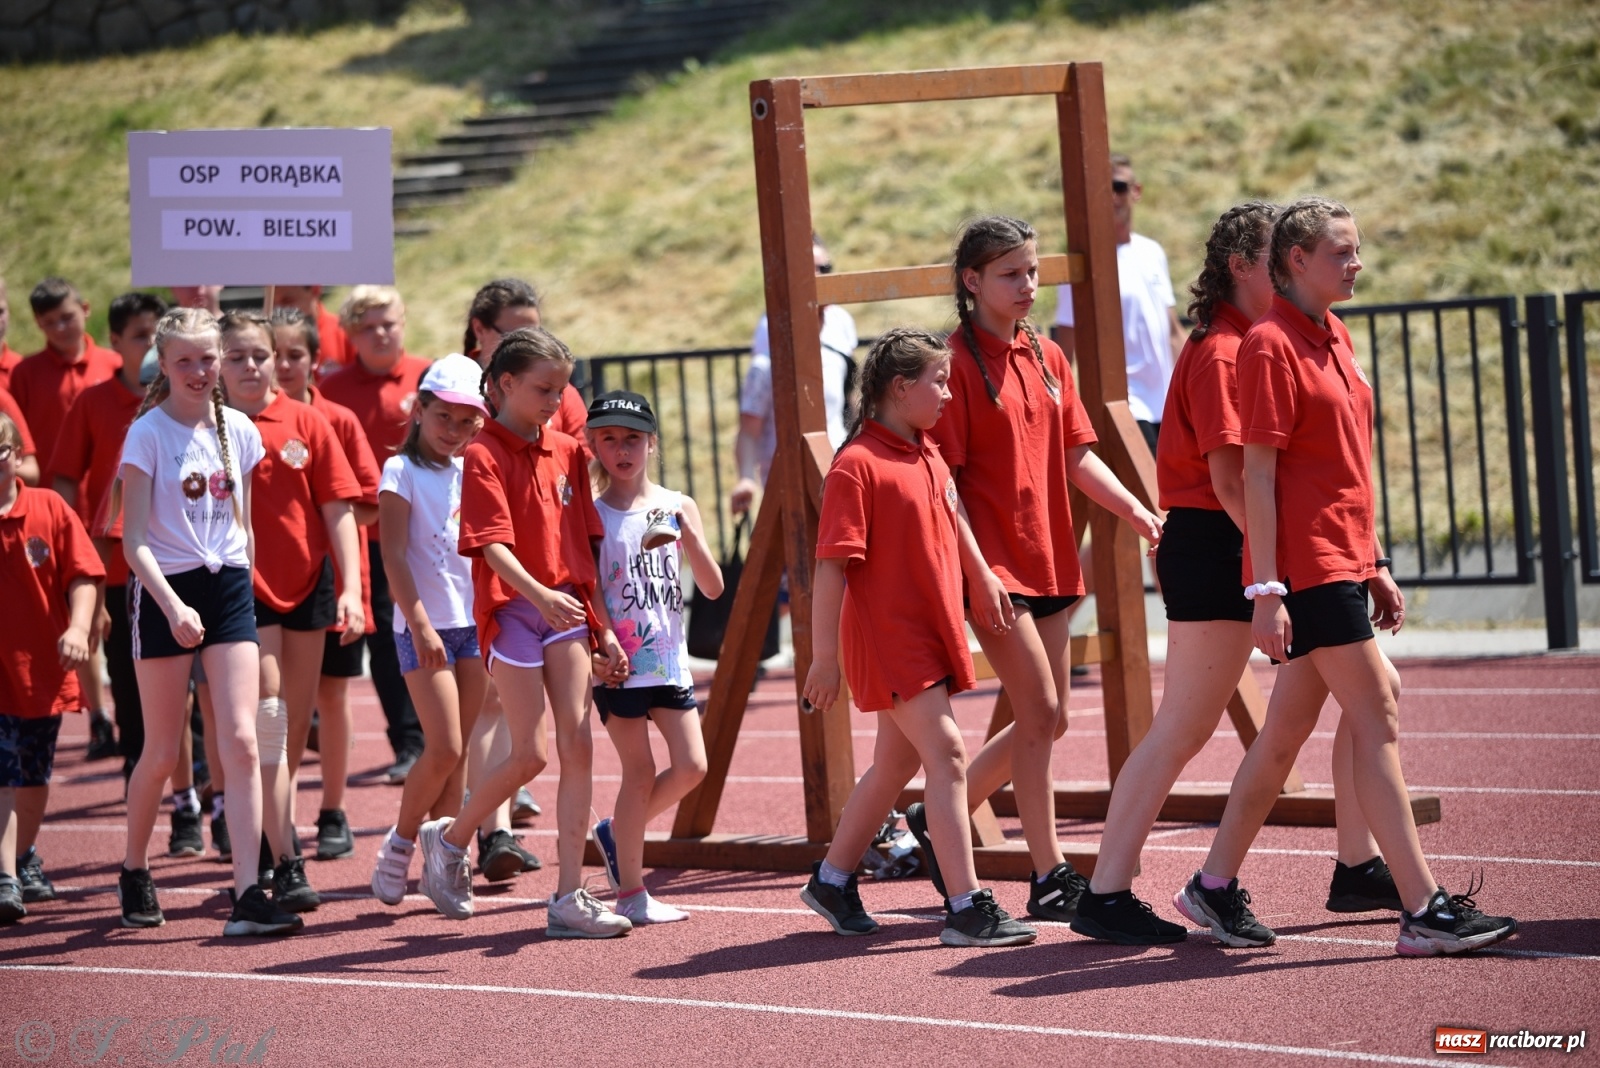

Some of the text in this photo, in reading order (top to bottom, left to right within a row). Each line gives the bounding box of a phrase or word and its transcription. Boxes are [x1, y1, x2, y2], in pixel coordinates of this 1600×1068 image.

[179, 164, 342, 188] OSP PORĄBKA
[183, 218, 337, 238] POW. BIELSKI
[174, 448, 205, 468] DONUT
[629, 553, 676, 581] HELLO
